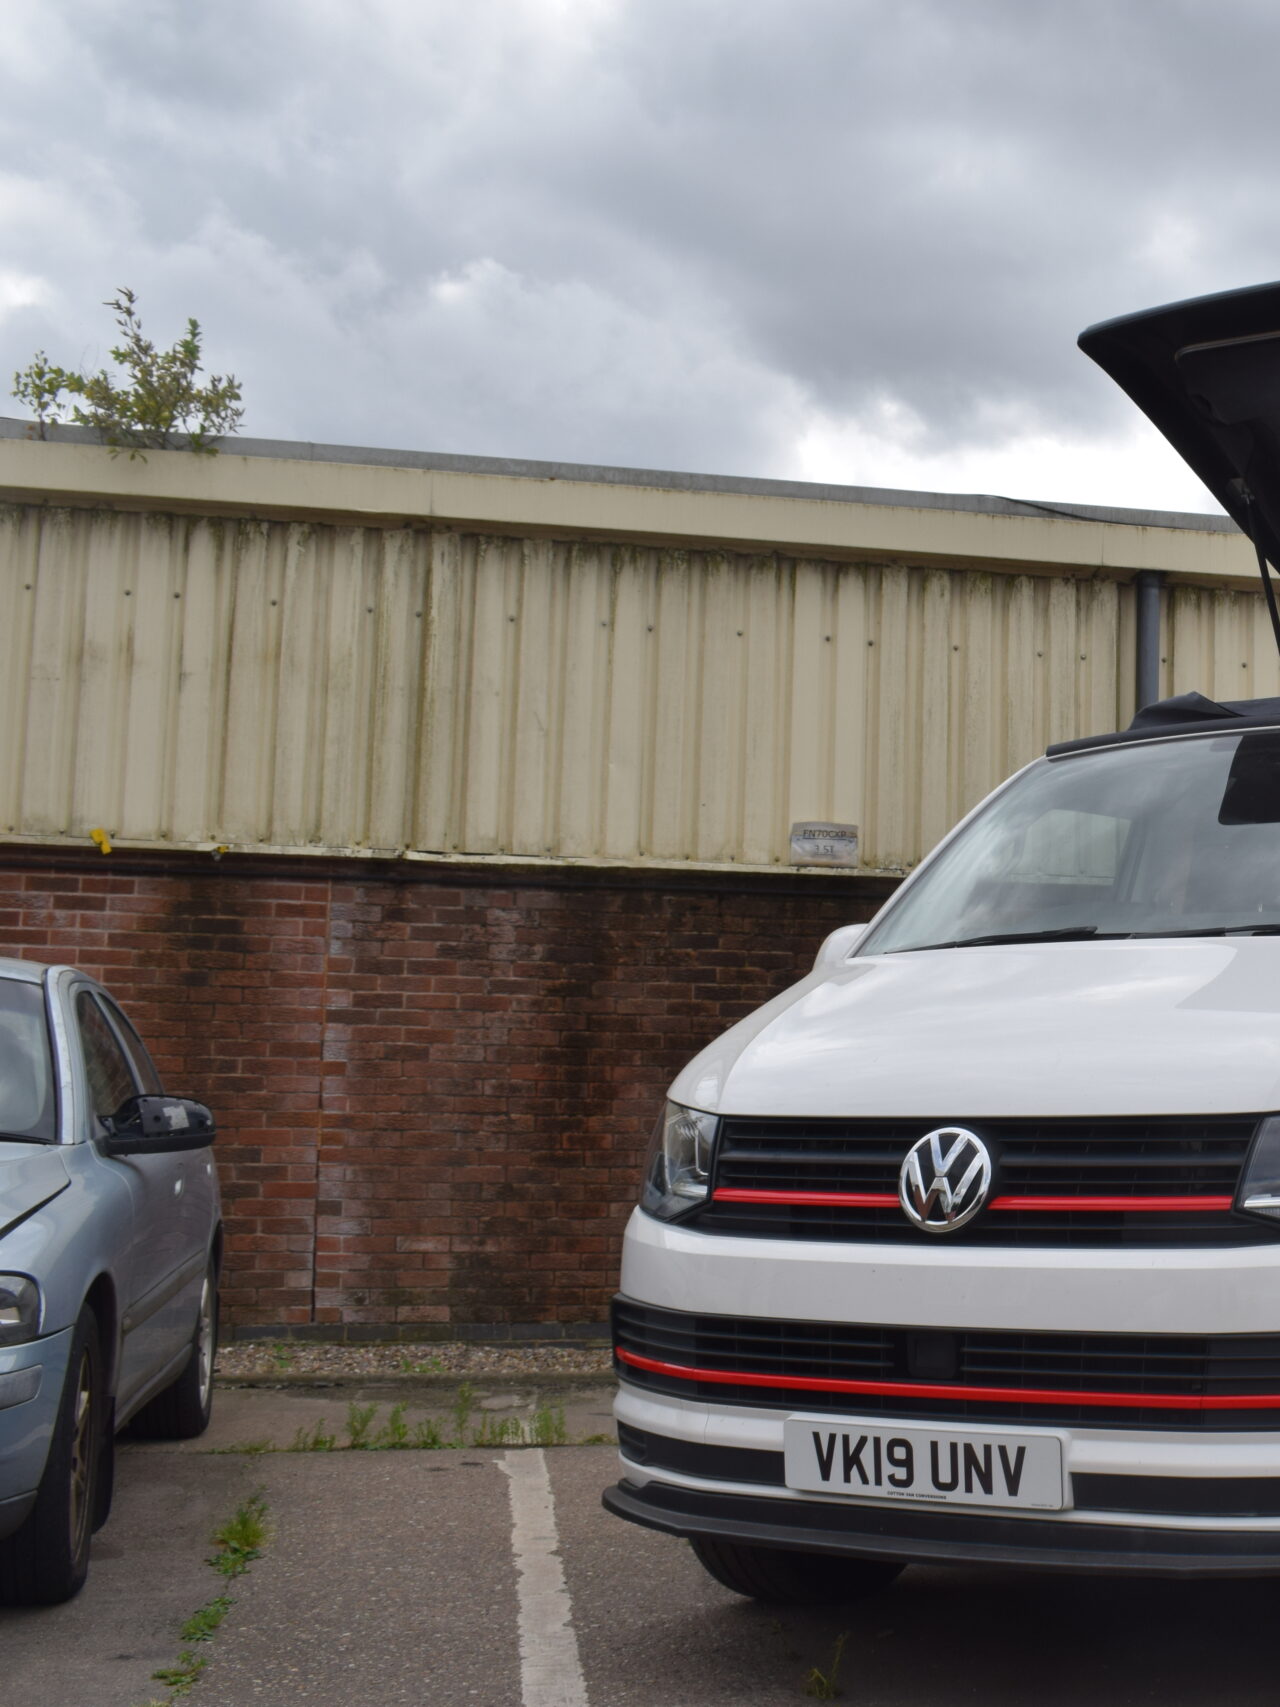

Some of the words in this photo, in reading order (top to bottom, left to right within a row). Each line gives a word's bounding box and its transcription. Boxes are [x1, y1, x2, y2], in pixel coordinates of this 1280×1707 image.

[899, 1127, 991, 1232] VW
[812, 1431, 914, 1489] VK19
[930, 1440, 1026, 1497] UNV
